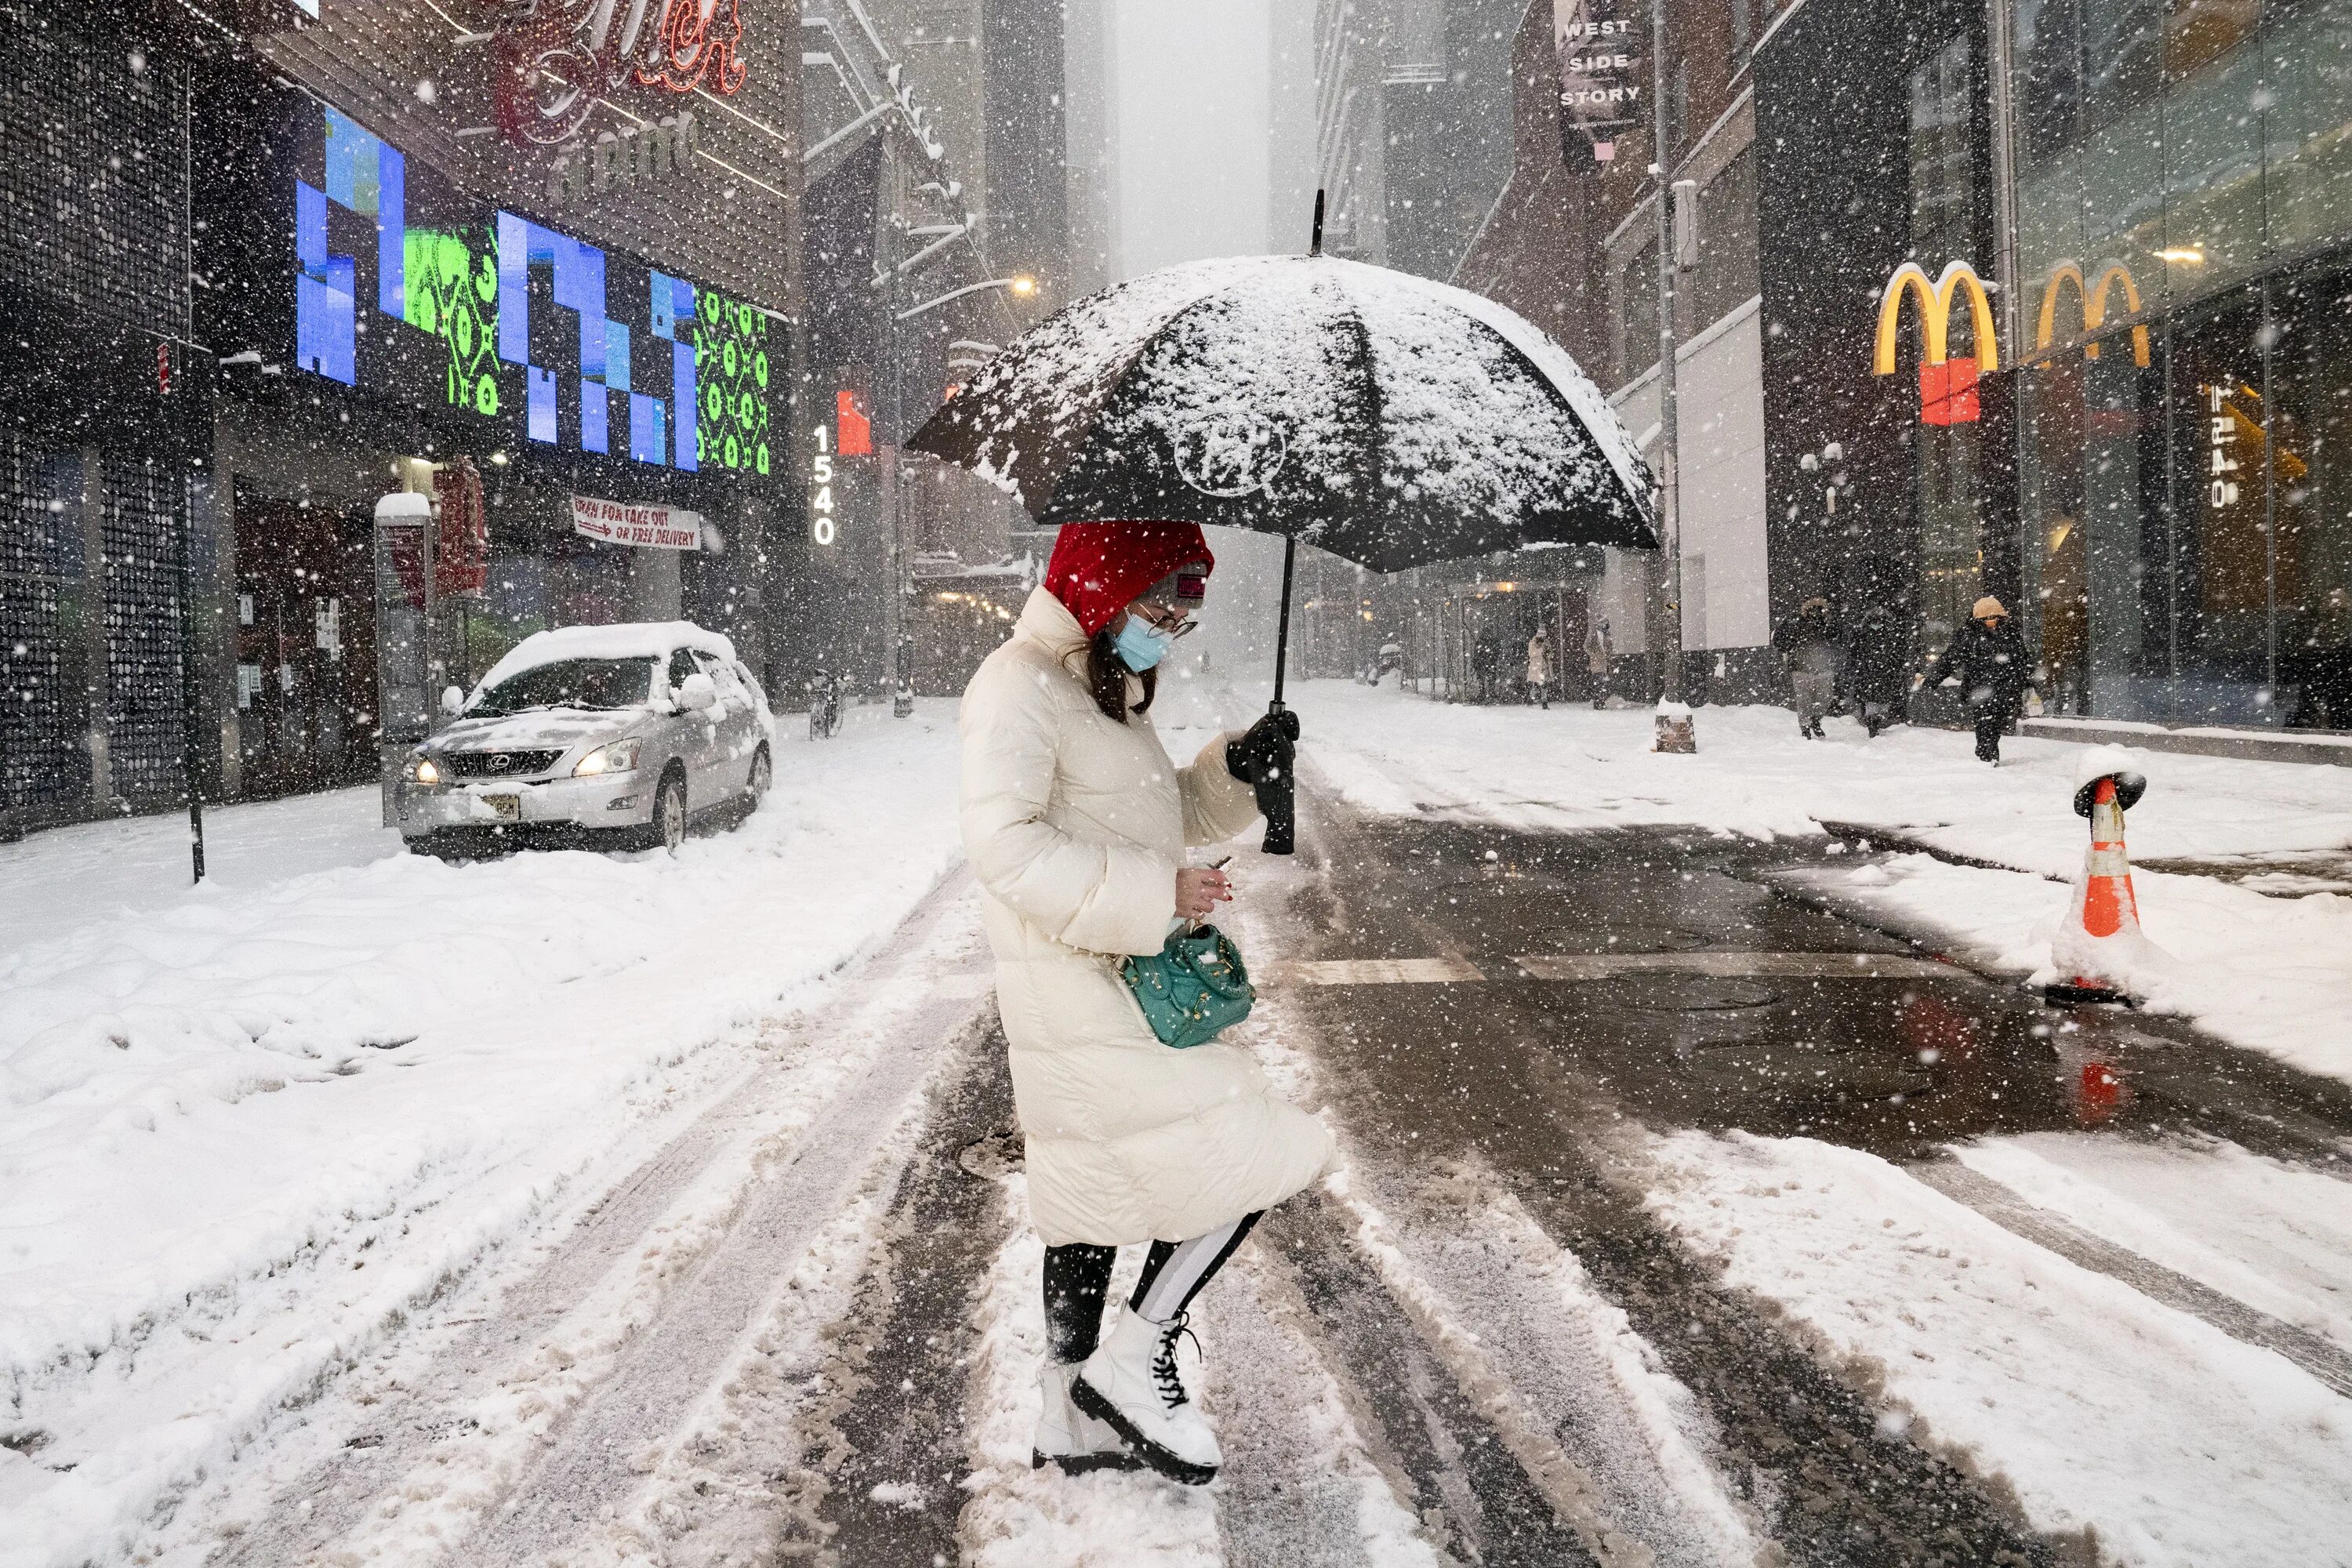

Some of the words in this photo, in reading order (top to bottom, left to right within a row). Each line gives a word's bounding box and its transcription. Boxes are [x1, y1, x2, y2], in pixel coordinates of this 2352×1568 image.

[1563, 20, 1630, 37] WEST
[1570, 54, 1628, 71] SIDE
[1560, 86, 1640, 106] STORY
[813, 425, 835, 545] 1540
[601, 503, 622, 522] FOR
[625, 508, 649, 525] TAKE
[651, 510, 669, 527] OUT
[616, 526, 629, 539] OR
[632, 527, 654, 543] FREE
[655, 528, 695, 546] DELIVERY
